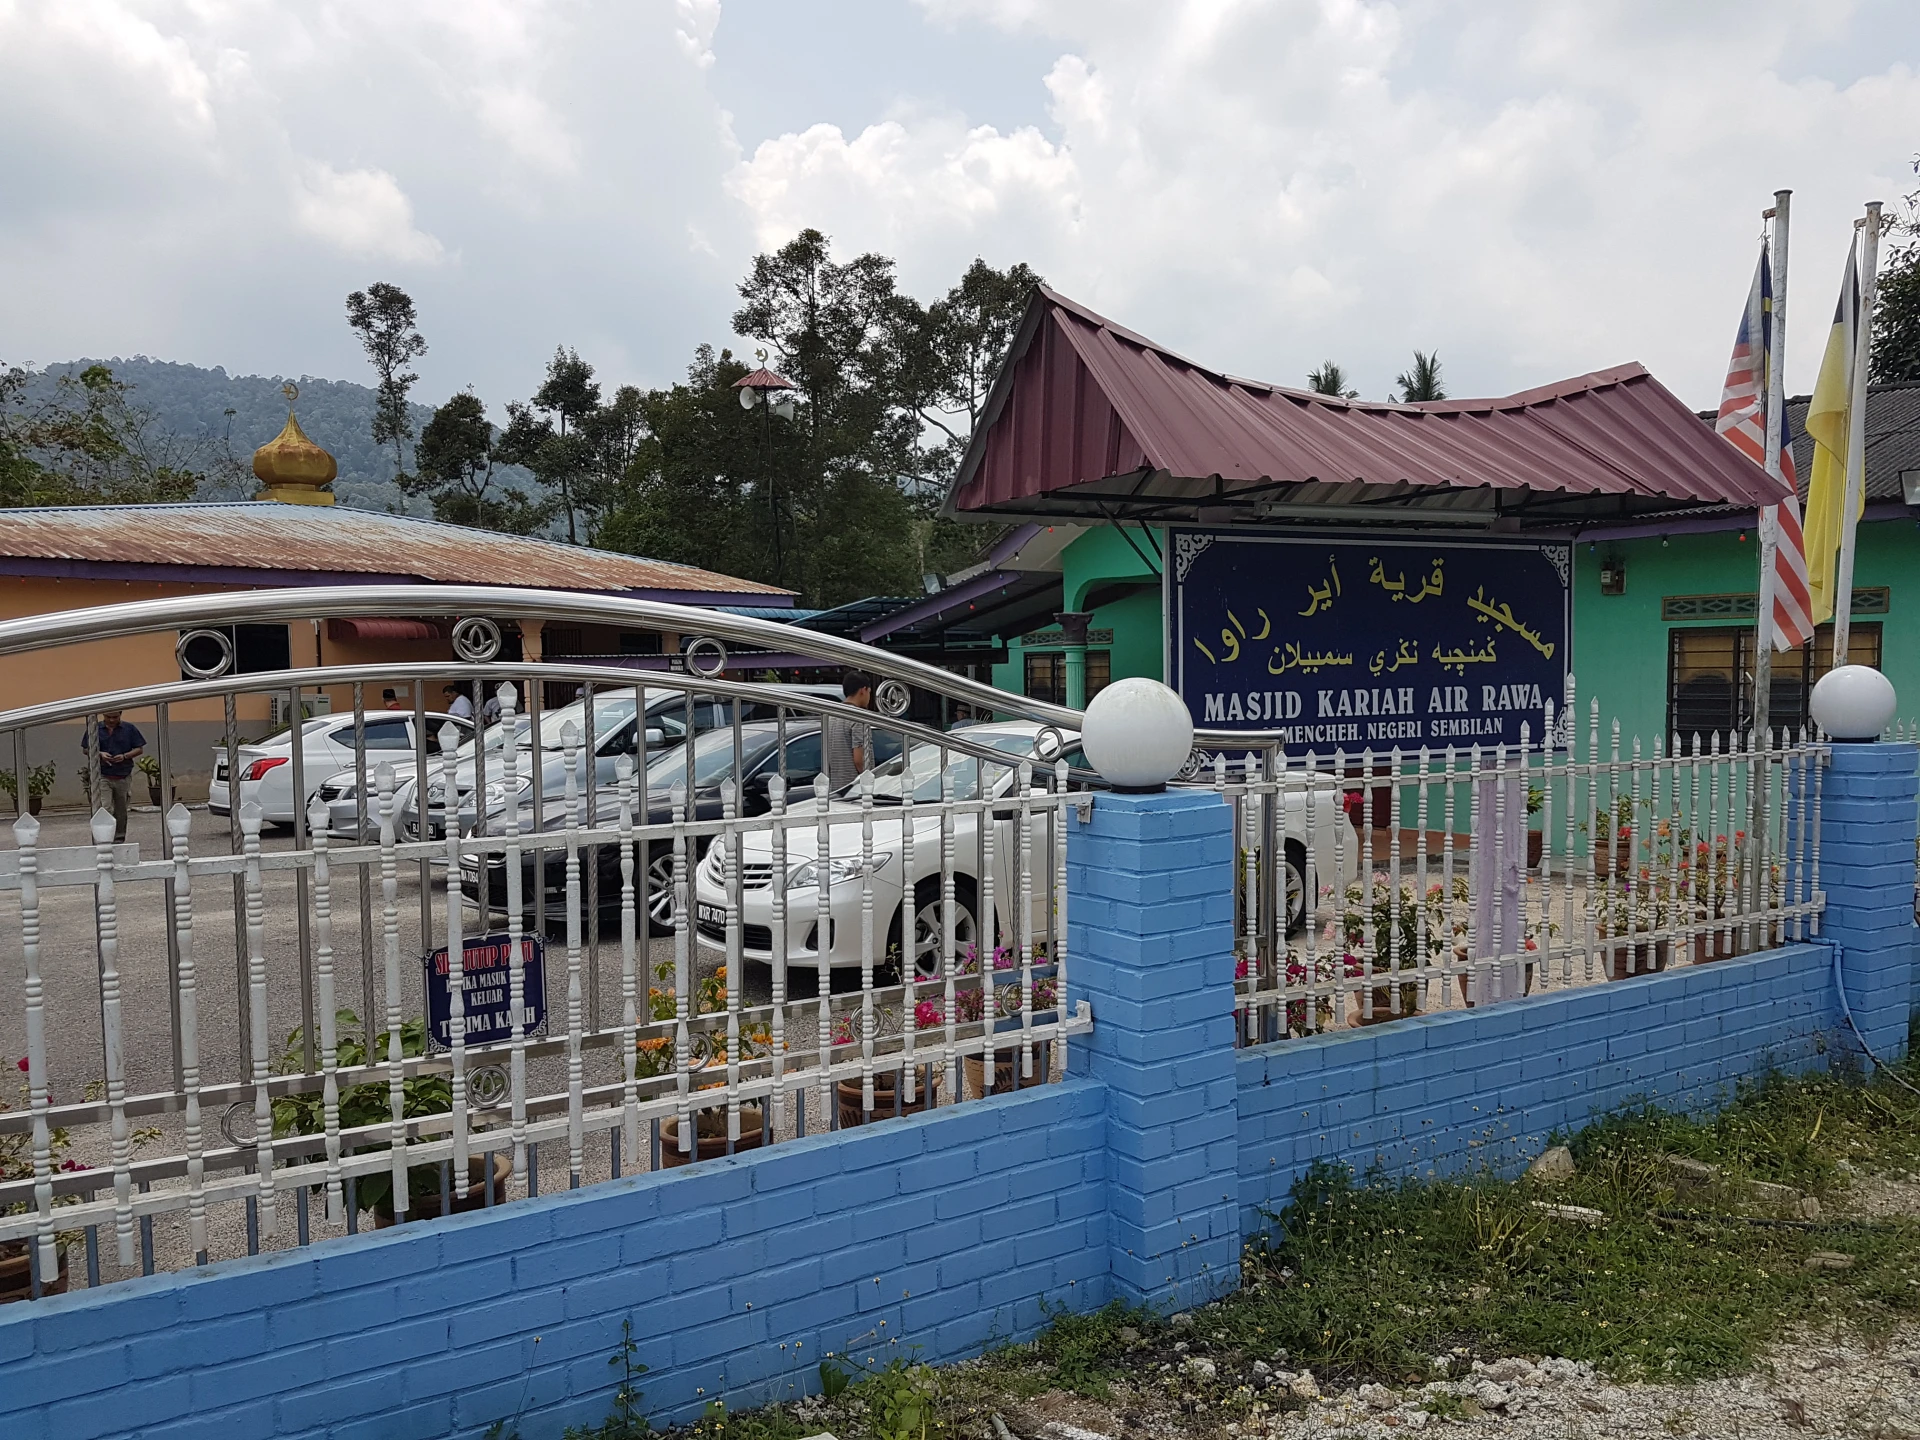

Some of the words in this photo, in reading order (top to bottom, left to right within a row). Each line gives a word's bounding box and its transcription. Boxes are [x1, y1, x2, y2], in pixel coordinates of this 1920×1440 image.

[1368, 556, 1445, 603] قرية
[1204, 691, 1302, 721] MASJID
[1317, 688, 1414, 718] KARIAH
[1427, 686, 1469, 713] AIR
[1482, 684, 1543, 710] RAWA
[1264, 722, 1363, 743] MENCHEH.
[1367, 720, 1422, 740] NEGERI
[1430, 718, 1503, 737] SEMBILAN
[699, 904, 710, 921] WXR
[711, 908, 725, 924] 7470
[463, 945, 499, 972] TUTUP
[500, 940, 535, 965] PTU
[446, 975, 477, 993] KIKA
[479, 971, 507, 988] MASUK
[471, 988, 503, 1006] KELUAR
[440, 1014, 492, 1038] TIMA
[495, 1007, 536, 1028] KAIH
